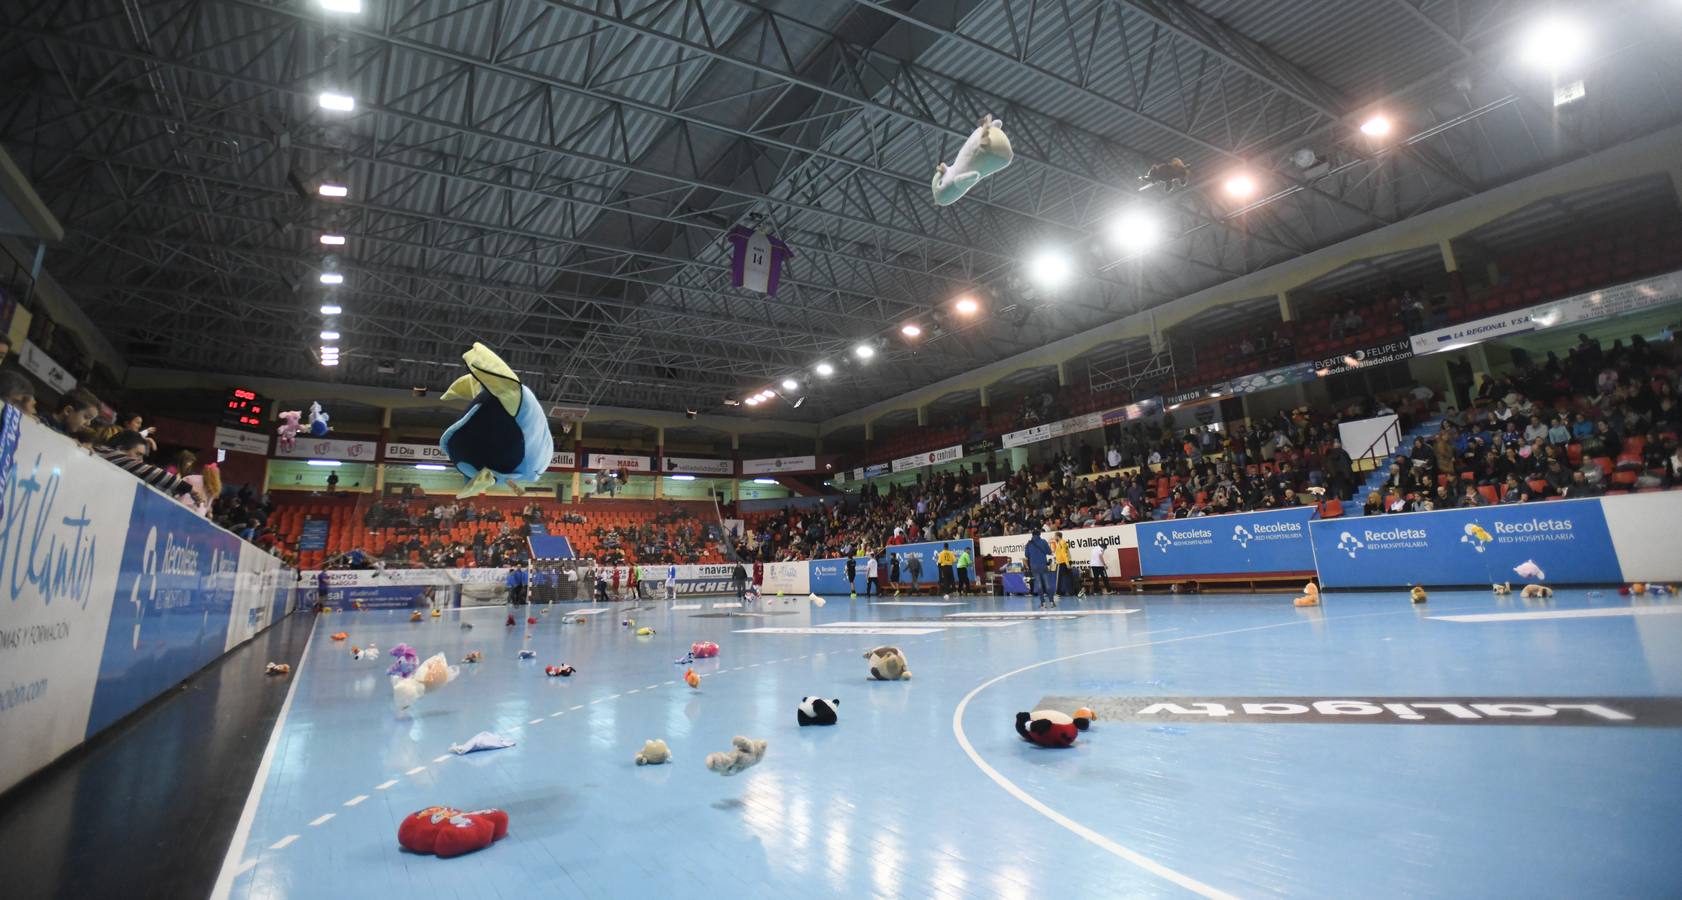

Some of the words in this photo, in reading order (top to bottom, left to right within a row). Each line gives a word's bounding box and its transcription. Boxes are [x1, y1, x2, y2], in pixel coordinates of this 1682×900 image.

[1466, 321, 1507, 337] REGIONAL
[390, 446, 398, 455] El
[423, 448, 431, 456] El
[550, 455, 574, 465] stilla
[1253, 522, 1302, 533] Recoletas
[1494, 518, 1573, 534] Recoletas
[1172, 529, 1212, 539] Recoletas
[1365, 528, 1426, 541] Recoletas
[1498, 536, 1513, 544] RED
[1514, 533, 1575, 543] HOSPITALARIA
[993, 544, 1025, 554] Ayuntami
[1066, 539, 1076, 549] de
[1076, 536, 1121, 549] Valladolid
[1367, 542, 1380, 550] RED
[1381, 540, 1428, 549] HOSPITALARIA
[674, 581, 753, 593] MICHELN
